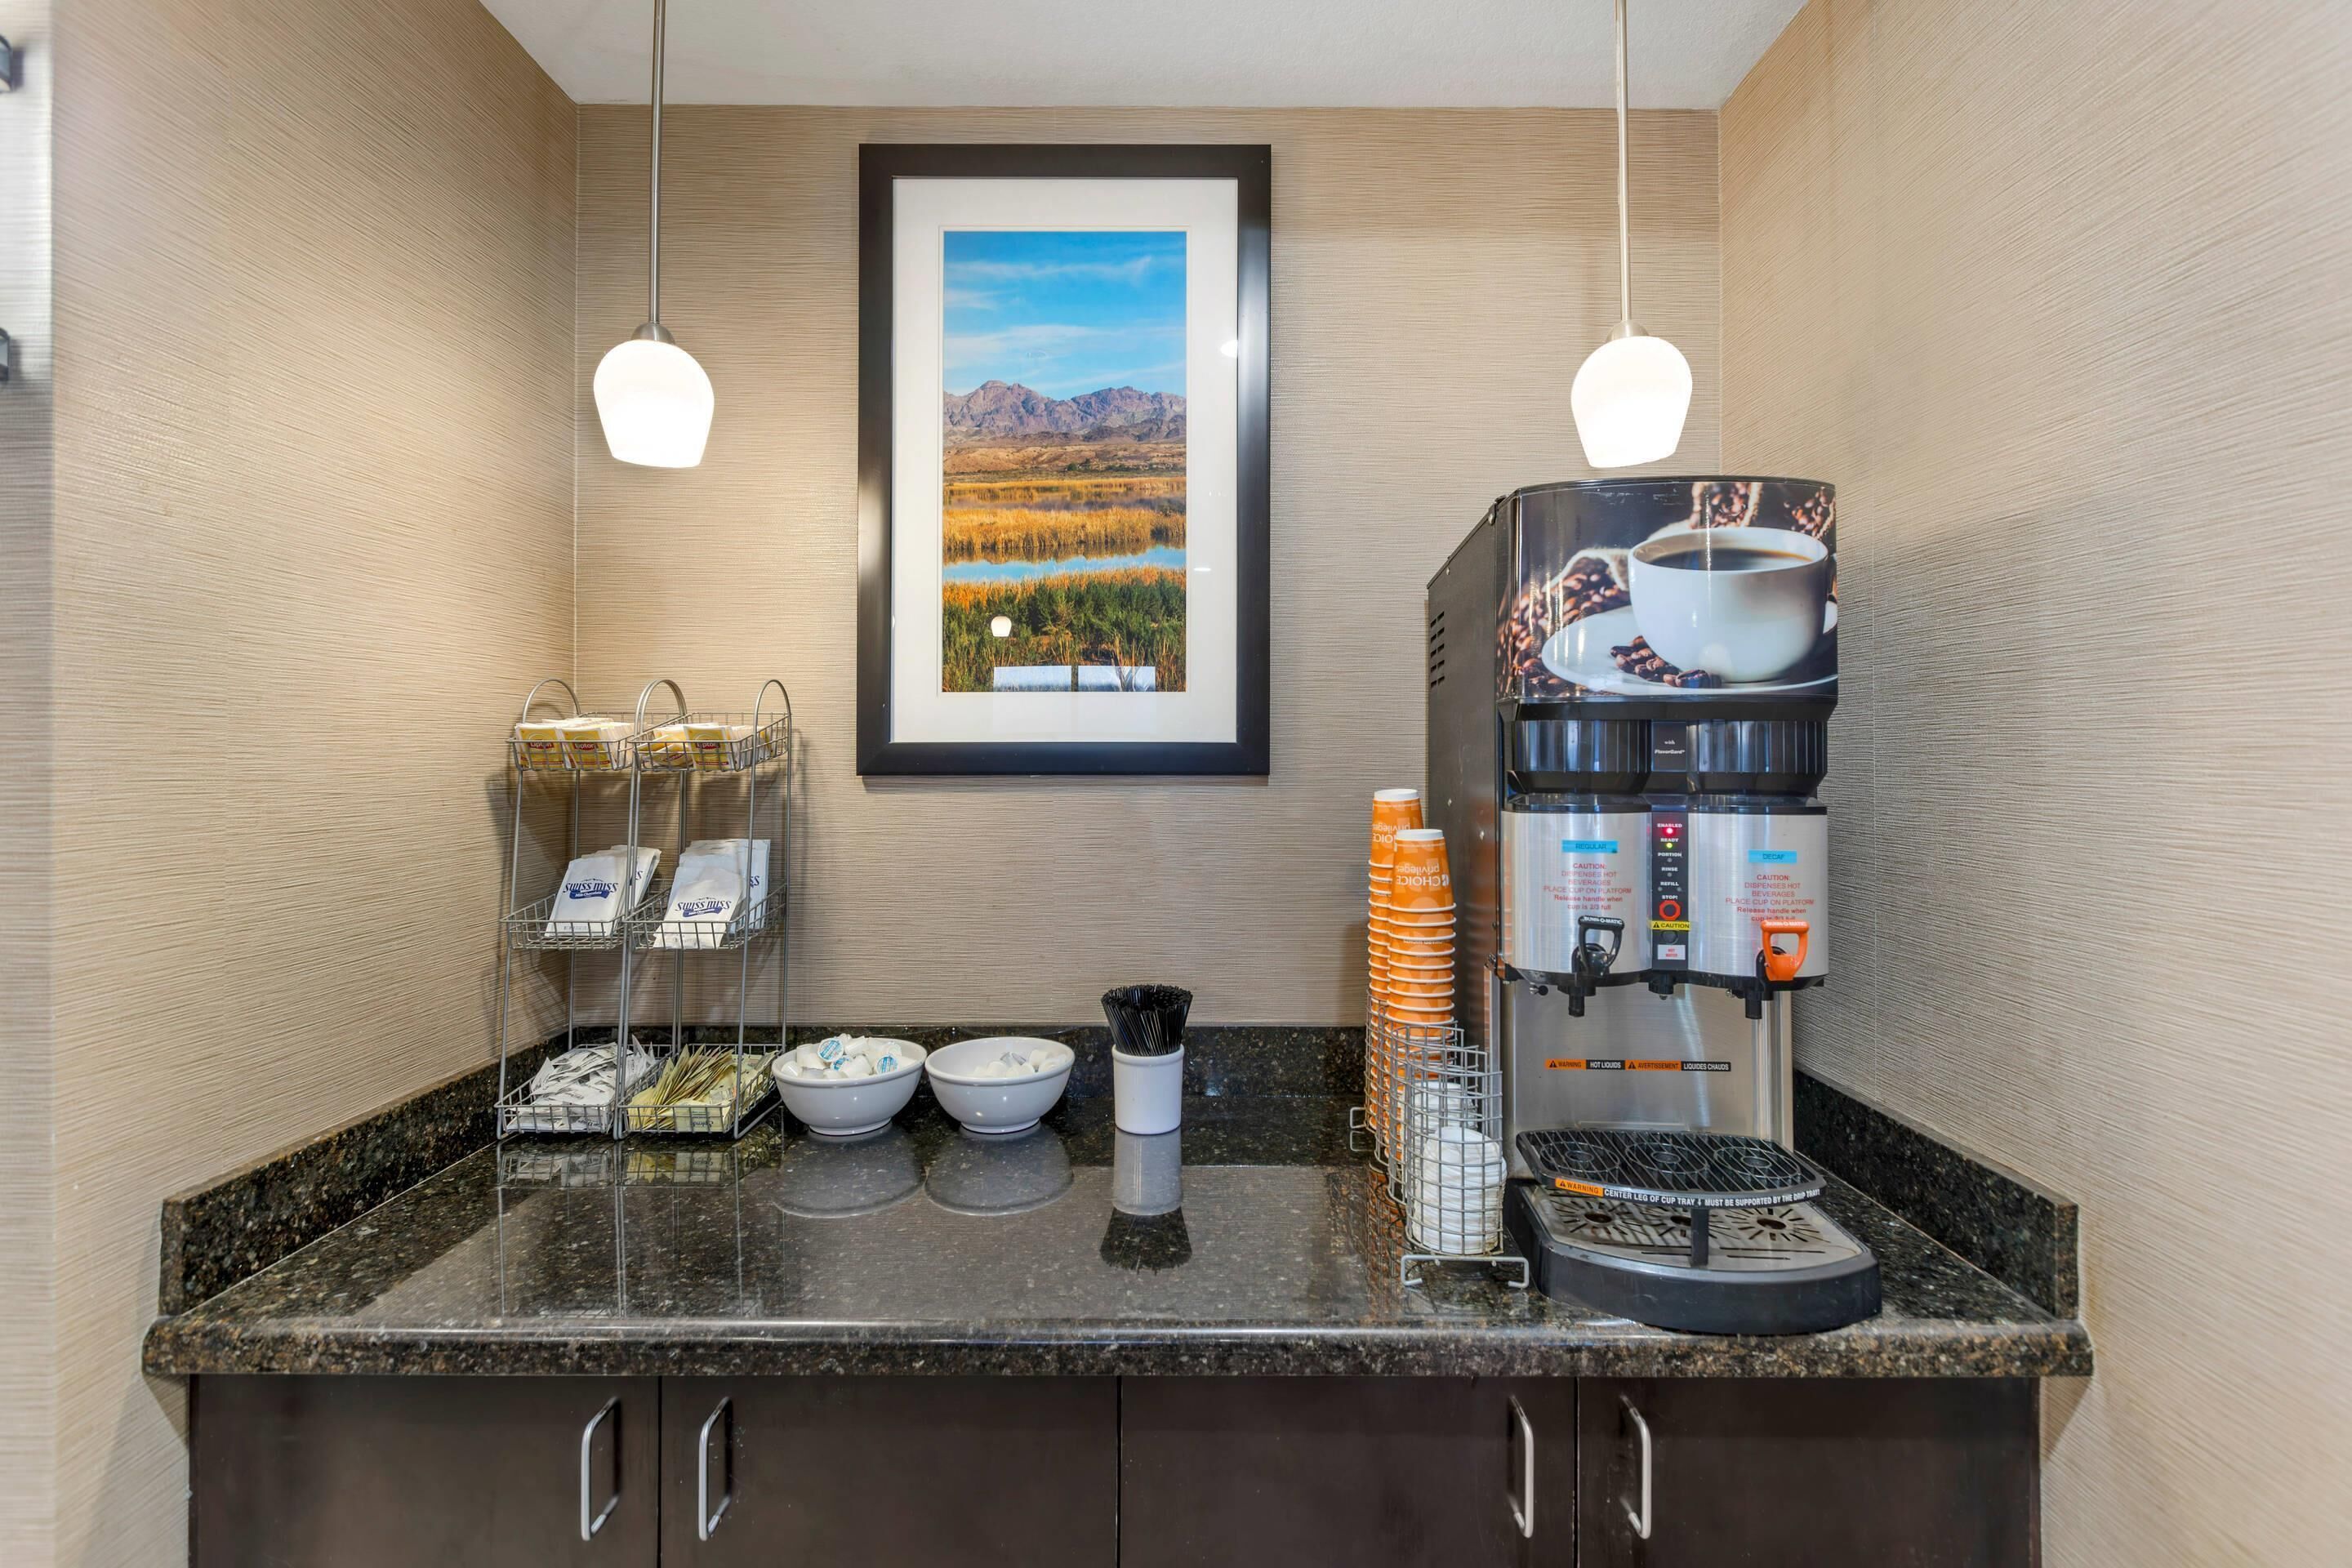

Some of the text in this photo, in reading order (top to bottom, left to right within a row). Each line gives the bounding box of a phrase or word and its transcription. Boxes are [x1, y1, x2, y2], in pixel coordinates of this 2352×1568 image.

[1396, 875, 1441, 887] CHOICE
[1544, 885, 1567, 893] PLACE
[1566, 1182, 1599, 1194] WARNING
[1605, 1189, 1633, 1200] CENTER
[1634, 1194, 1648, 1202] LEG
[1677, 1197, 1695, 1205] TRAY
[1725, 1199, 1734, 1207] BE
[1735, 1197, 1772, 1207] SUPPORTED
[1793, 1192, 1806, 1200] DRIP
